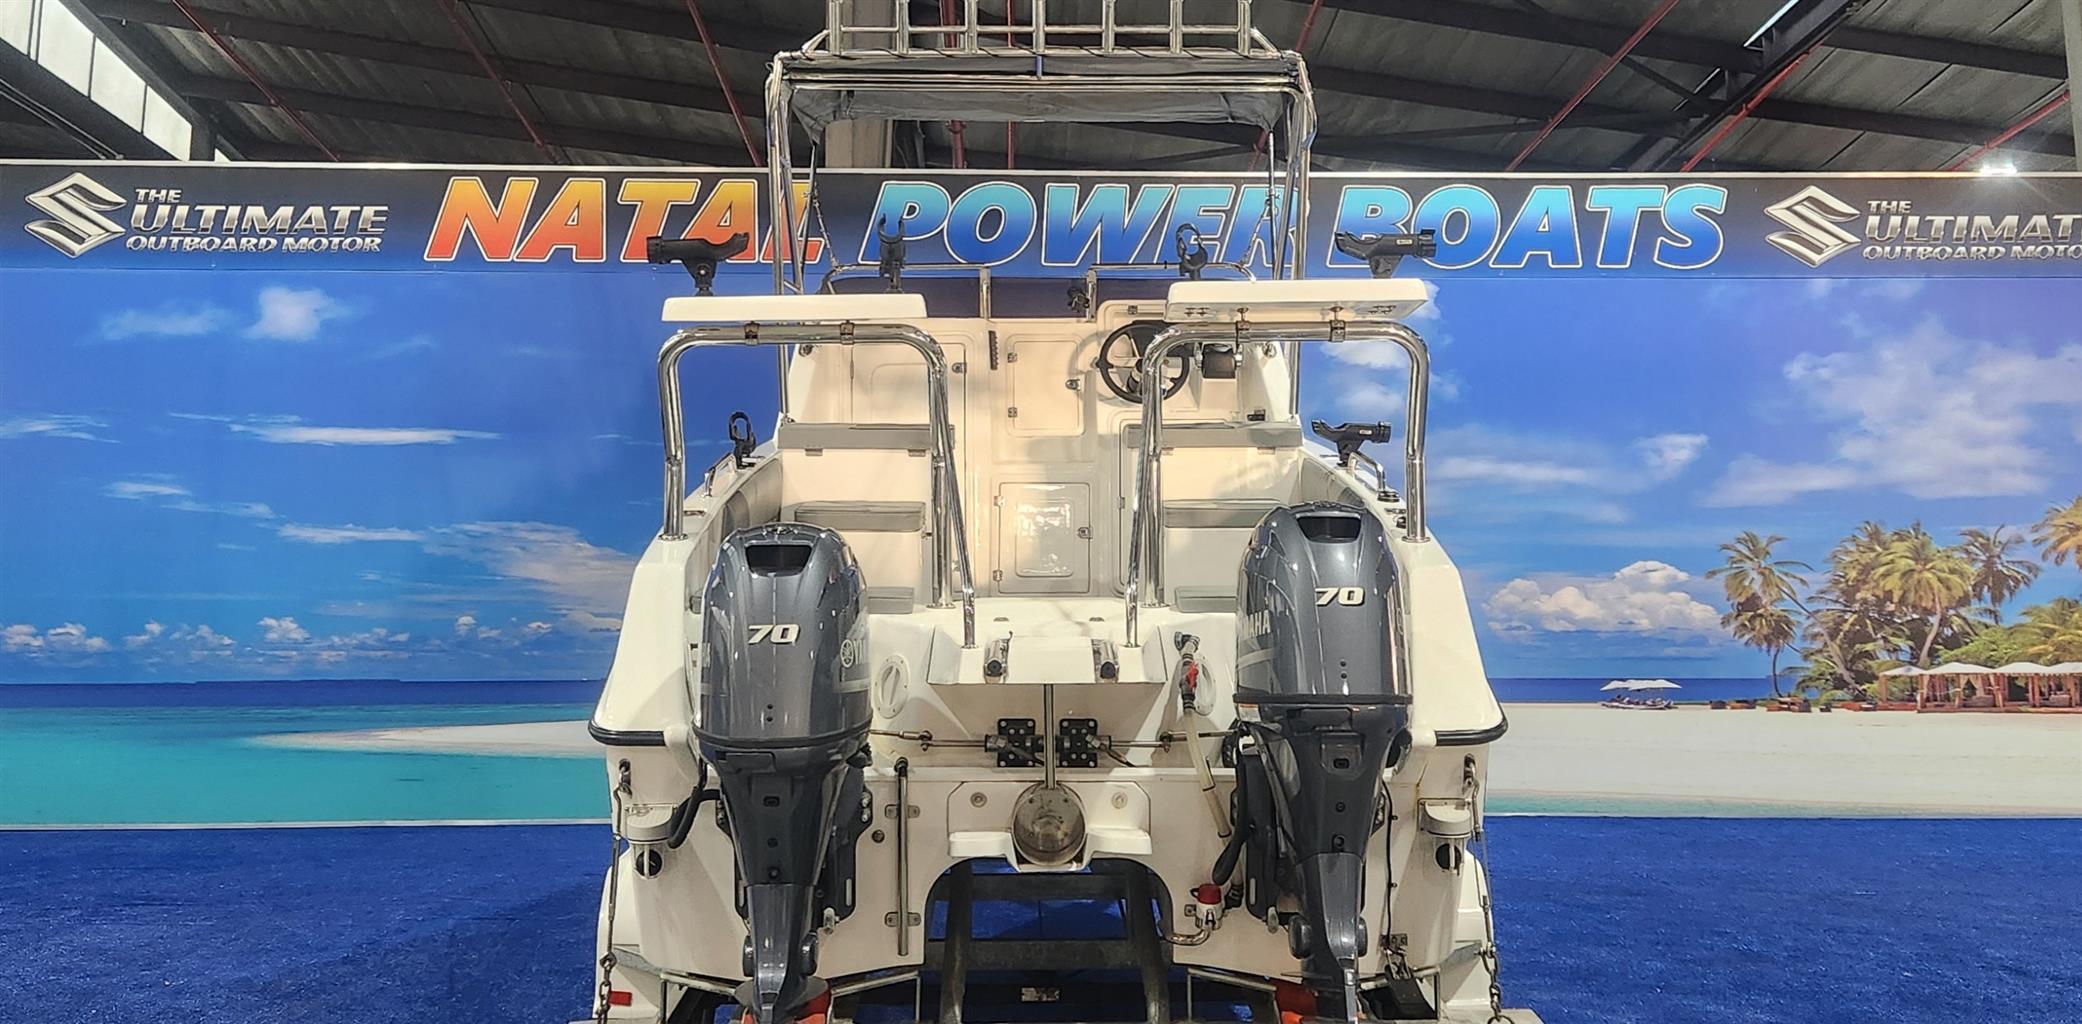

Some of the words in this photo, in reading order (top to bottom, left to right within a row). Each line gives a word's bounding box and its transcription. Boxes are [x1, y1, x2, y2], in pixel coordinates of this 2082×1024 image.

[135, 188, 182, 203] THE
[1867, 200, 1912, 214] THE
[130, 204, 388, 235] ULTIMATE
[424, 178, 825, 263] NATAL
[858, 180, 1300, 266] POWER
[1328, 183, 1728, 270] BOATS
[1865, 214, 2082, 243] ULTIMAT
[126, 235, 278, 252] OUTBOARD
[282, 236, 382, 253] MOTOR
[1863, 245, 2006, 260] OUTBOARD
[1315, 586, 1365, 607] 70
[748, 623, 801, 645] 70
